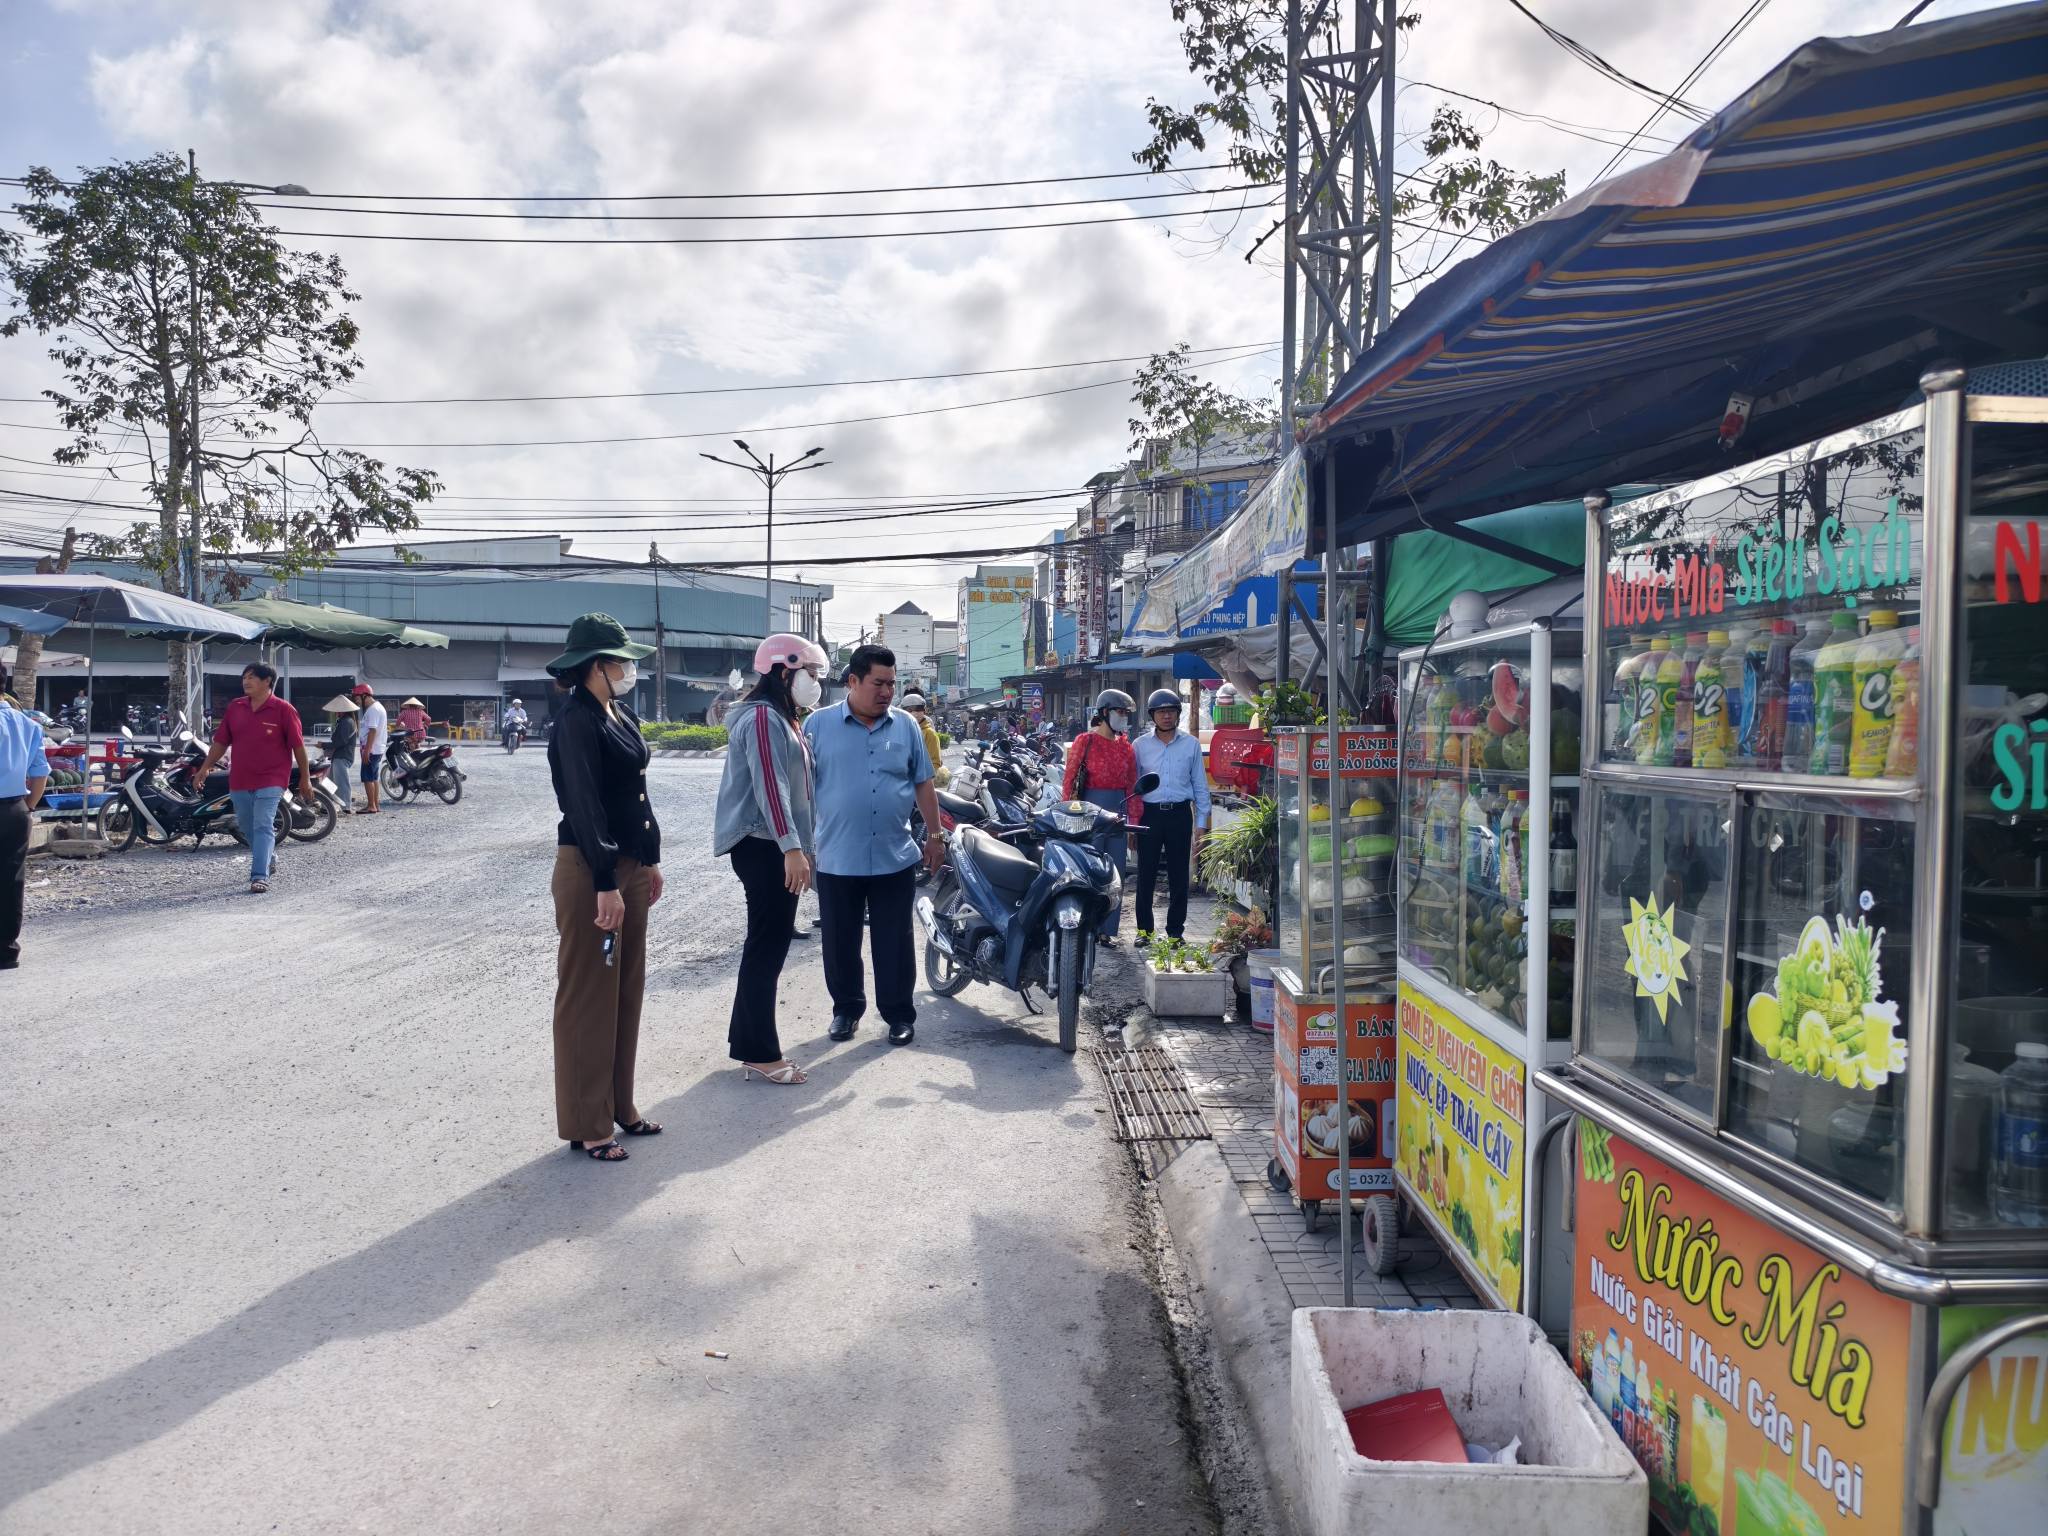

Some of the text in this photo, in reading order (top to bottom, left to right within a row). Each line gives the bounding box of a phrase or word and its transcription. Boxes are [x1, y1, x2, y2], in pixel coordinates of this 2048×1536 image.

[1604, 496, 1910, 627] Nước Mía Siêu Sạch
[1694, 682, 1724, 717] C2
[1346, 736, 1389, 750] BÁNH
[1339, 753, 1361, 770] BẢO
[1356, 1015, 1397, 1038] BÁN
[1367, 1047, 1391, 1083] BẢO
[1437, 1024, 1488, 1095] NGUYÊN
[1406, 1051, 1434, 1106] NƯỚC
[1435, 1075, 1449, 1122] ÉP
[1450, 1090, 1480, 1152] TRÁI
[1482, 1121, 1514, 1180] CÂY
[1360, 1169, 1393, 1185] 0372.
[1609, 1169, 1874, 1429] Nước Mía
[1590, 1255, 1637, 1324] Nước
[1642, 1297, 1684, 1362] Giải
[1689, 1328, 1742, 1412] Khát
[1747, 1377, 1795, 1456] Các
[1801, 1420, 1864, 1518] Loại
